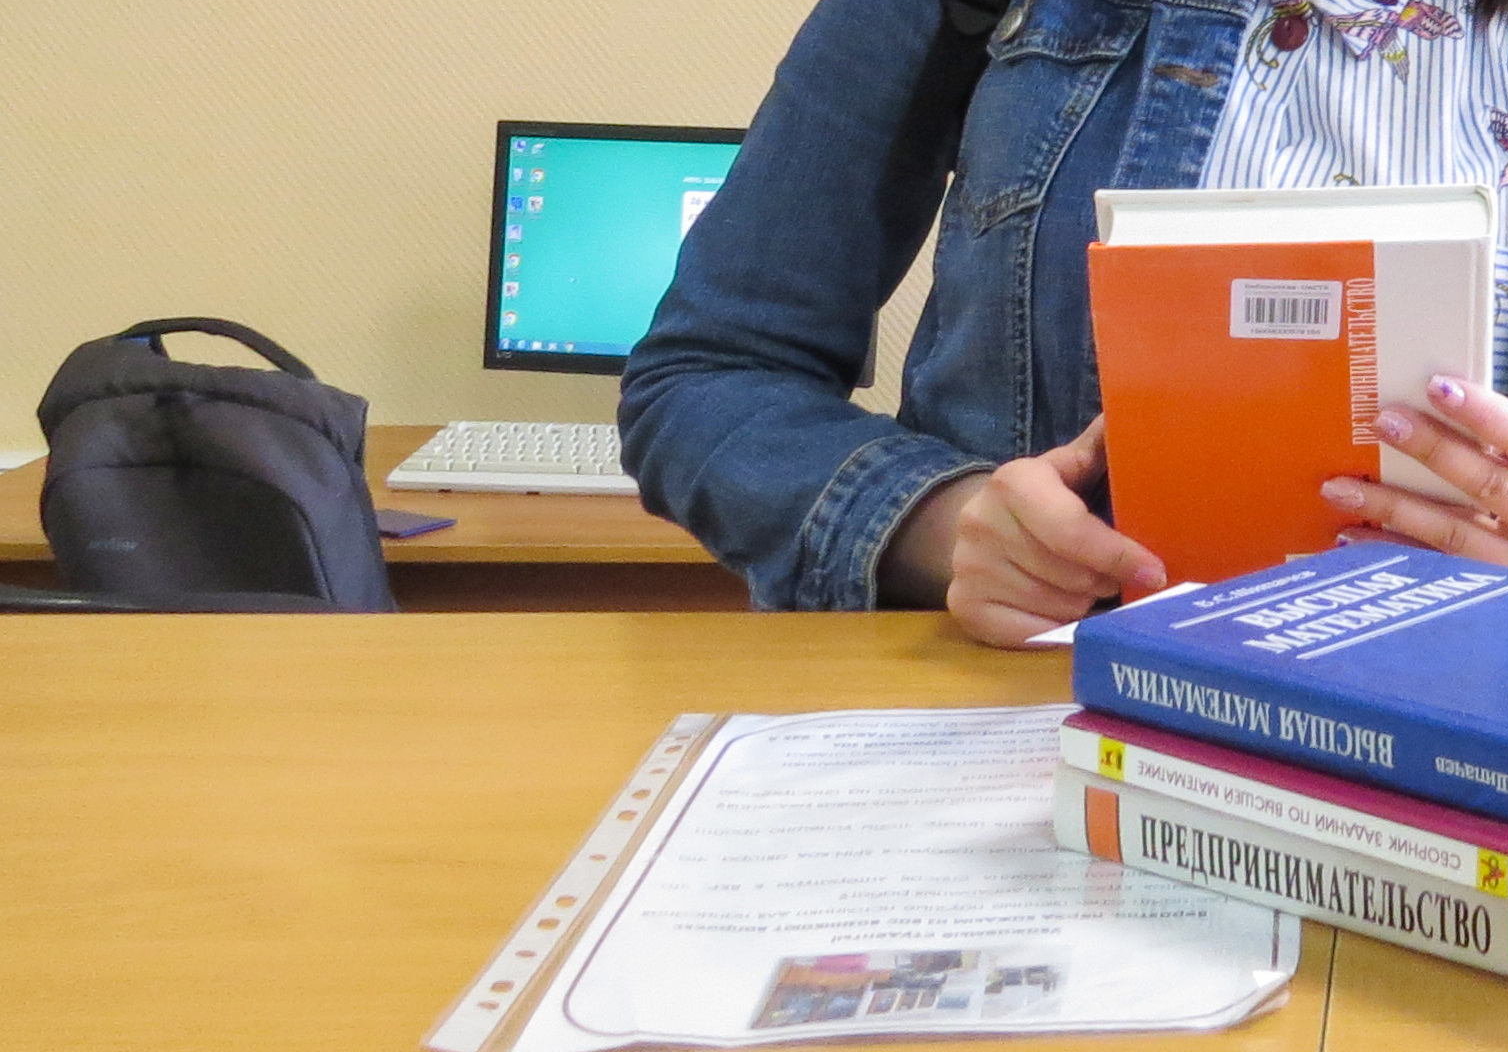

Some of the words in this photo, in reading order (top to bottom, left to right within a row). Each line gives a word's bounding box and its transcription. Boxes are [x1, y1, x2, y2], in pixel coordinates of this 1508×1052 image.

[1232, 570, 1420, 631] ВЫСШАЯ
[1241, 571, 1508, 655] МАТЕМАТИКА
[1110, 661, 1272, 737] МАТЕМАТИКА
[1277, 706, 1395, 770] ВЫСШАЯ
[1137, 759, 1220, 798] МАТЕМАТИКЕ
[1223, 785, 1284, 818] ВЫСШЕЙ
[1287, 805, 1312, 825] ПО
[1313, 814, 1383, 848] ЗАДАНИЙ
[1389, 835, 1462, 871] СБОРНИК
[1139, 813, 1493, 957] ПРЕДПРИНИМАТЕЛЬСТВО
